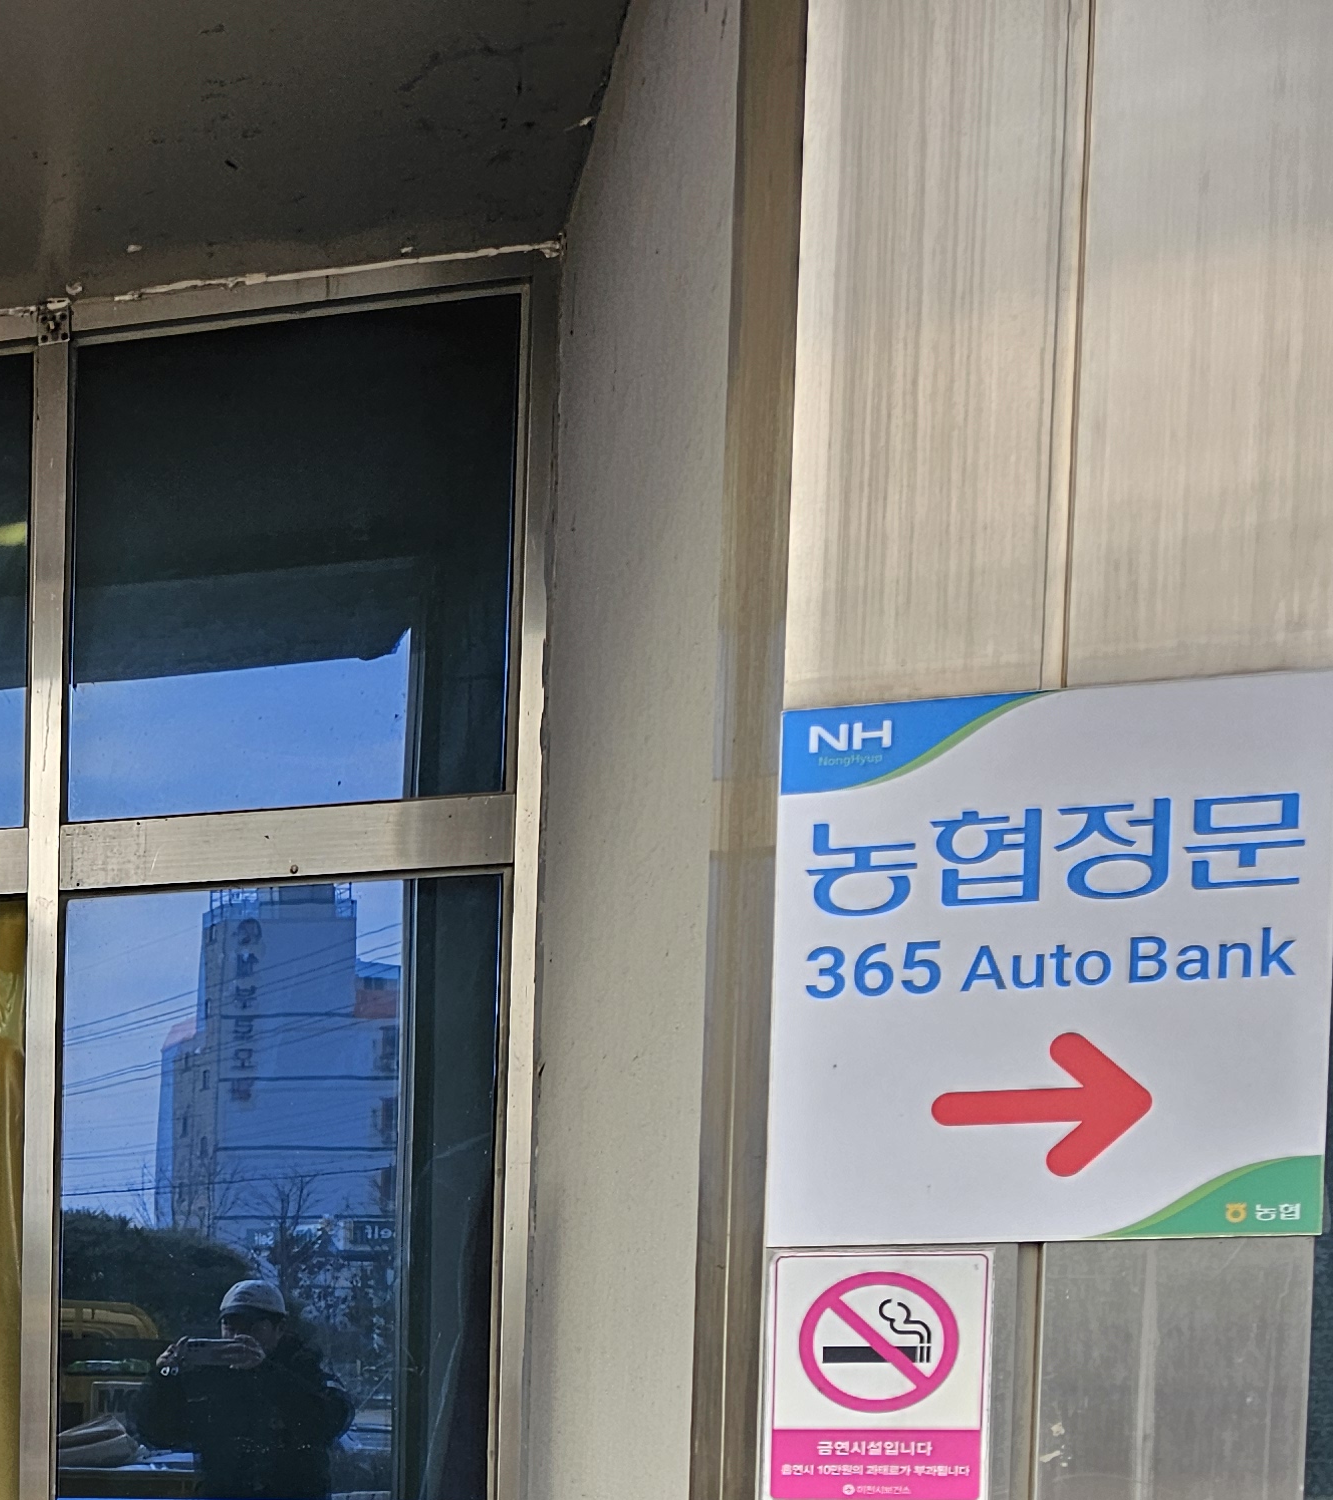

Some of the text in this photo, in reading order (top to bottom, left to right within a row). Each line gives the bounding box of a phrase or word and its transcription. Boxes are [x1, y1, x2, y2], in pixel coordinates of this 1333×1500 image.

[808, 719, 892, 754] NH
[817, 753, 883, 768] NongHyup
[804, 792, 1306, 917] 농협정문
[804, 927, 1296, 1000] 365 Auto Bank
[1255, 1202, 1302, 1222] 농협
[817, 1440, 933, 1457] 금연시설입니다
